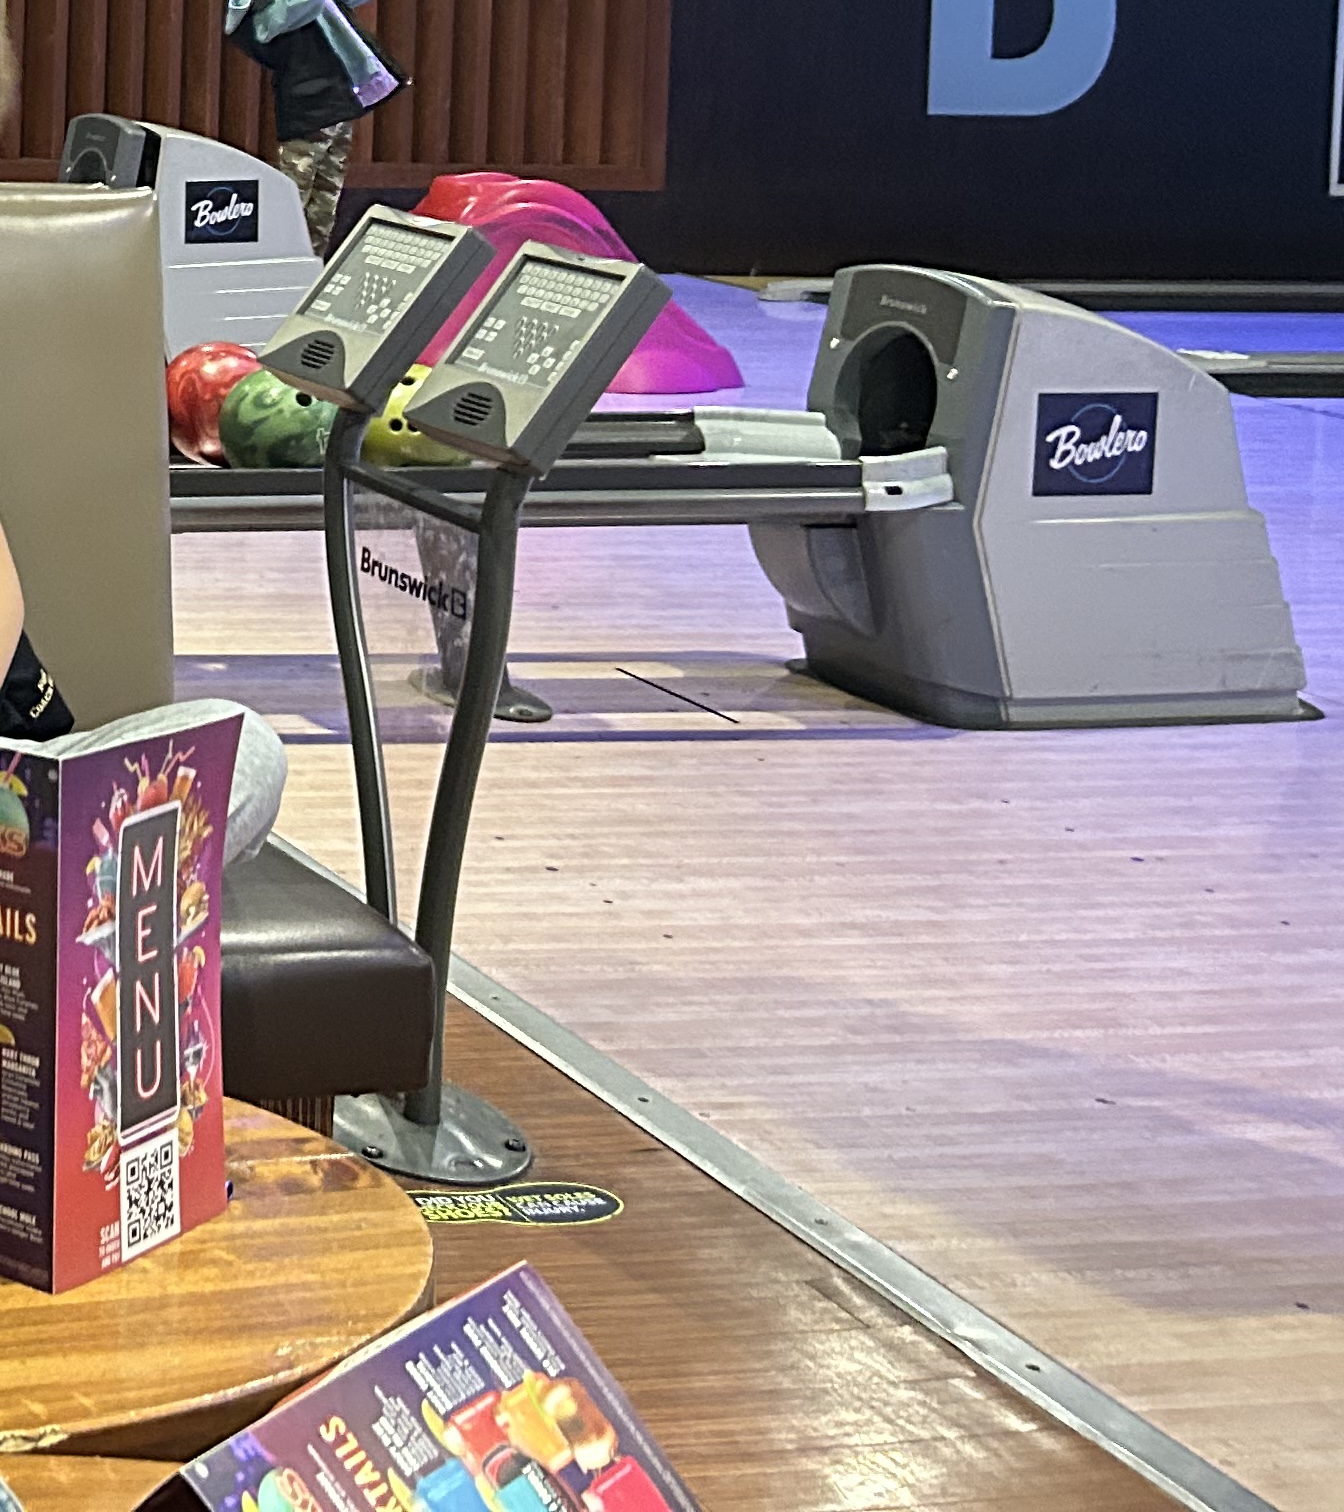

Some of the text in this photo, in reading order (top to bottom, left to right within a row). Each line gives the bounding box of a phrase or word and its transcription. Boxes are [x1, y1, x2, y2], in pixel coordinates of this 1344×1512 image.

[191, 193, 254, 228] Bowlero
[1045, 414, 1148, 469] Bowlero
[361, 546, 449, 611] Brunswick
[132, 836, 163, 1099] MENU
[414, 1194, 495, 1206] DID YOU
[100, 1220, 119, 1245] SCAN
